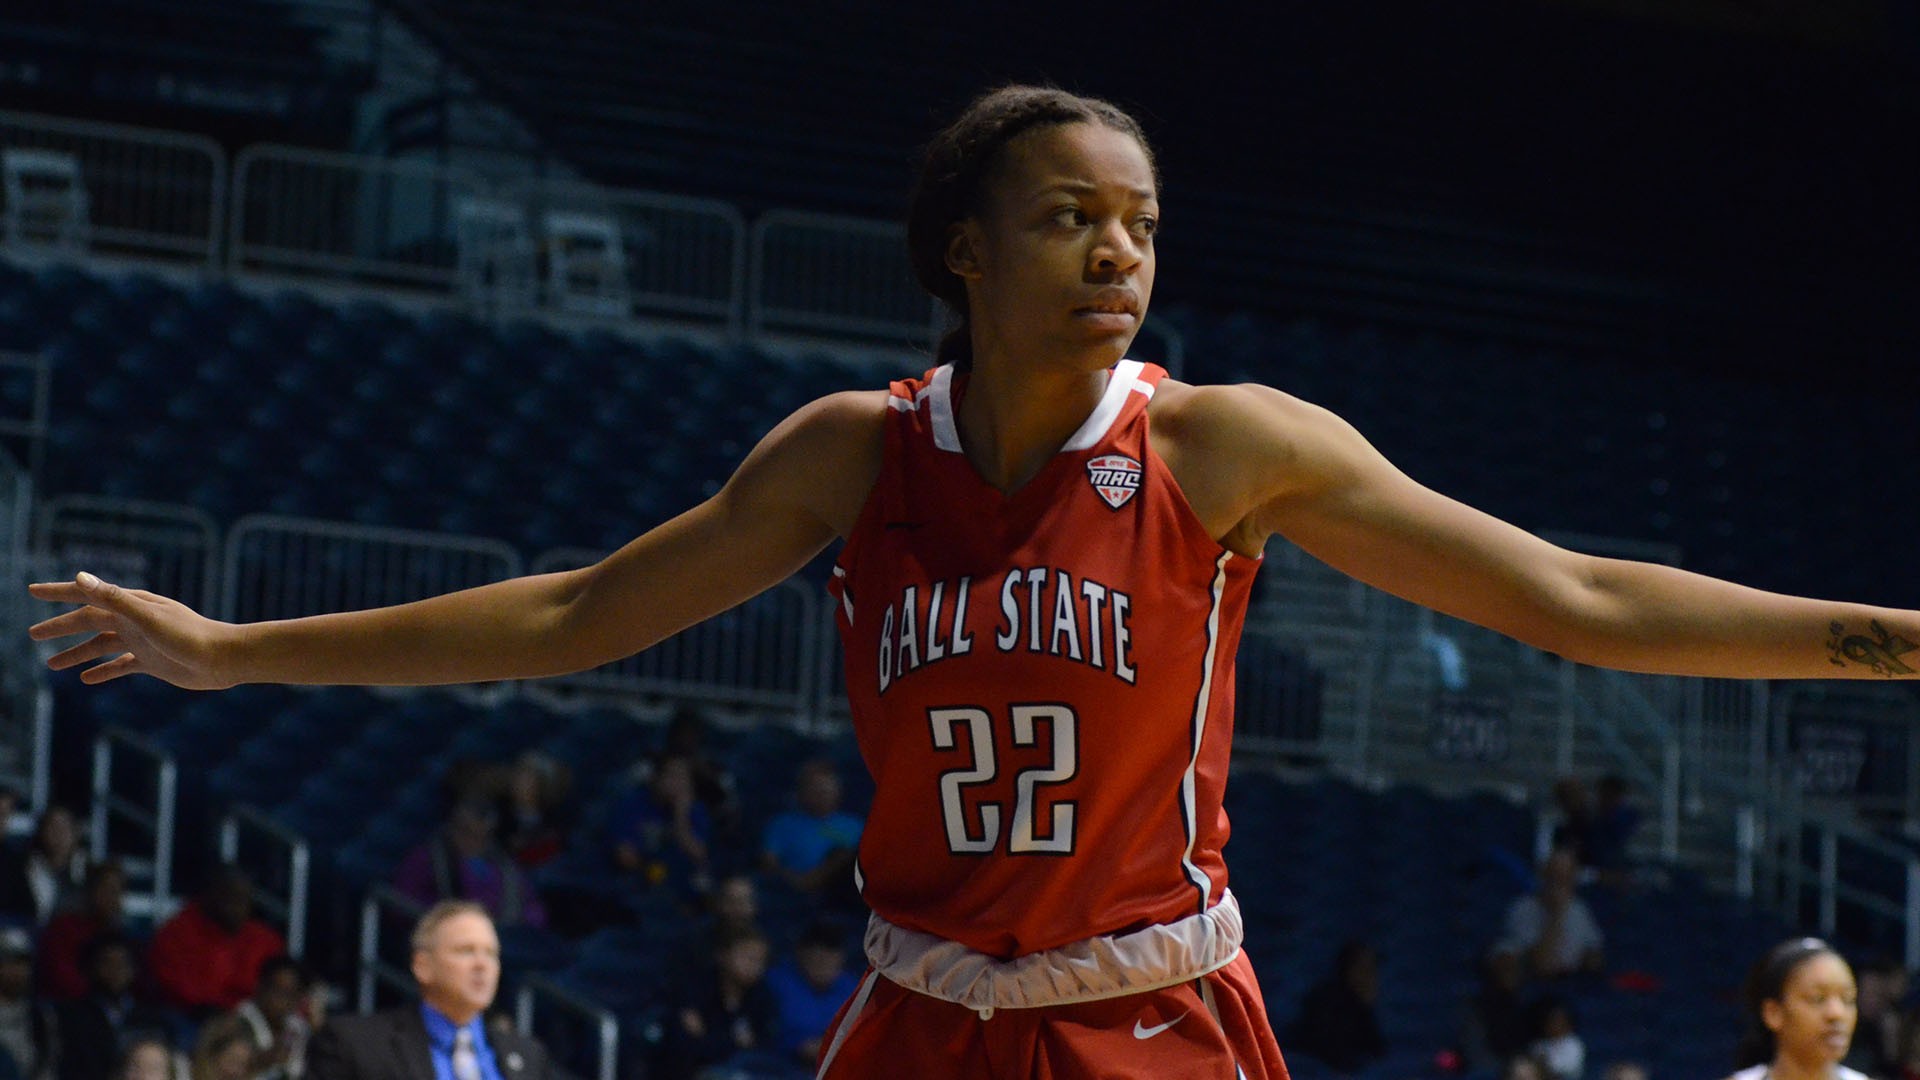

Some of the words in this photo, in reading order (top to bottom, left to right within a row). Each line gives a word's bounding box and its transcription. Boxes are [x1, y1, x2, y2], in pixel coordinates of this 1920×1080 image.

[1090, 469, 1141, 487] MAC
[878, 575, 974, 695] BALL
[996, 566, 1137, 686] STATE
[927, 703, 1079, 856] 22
